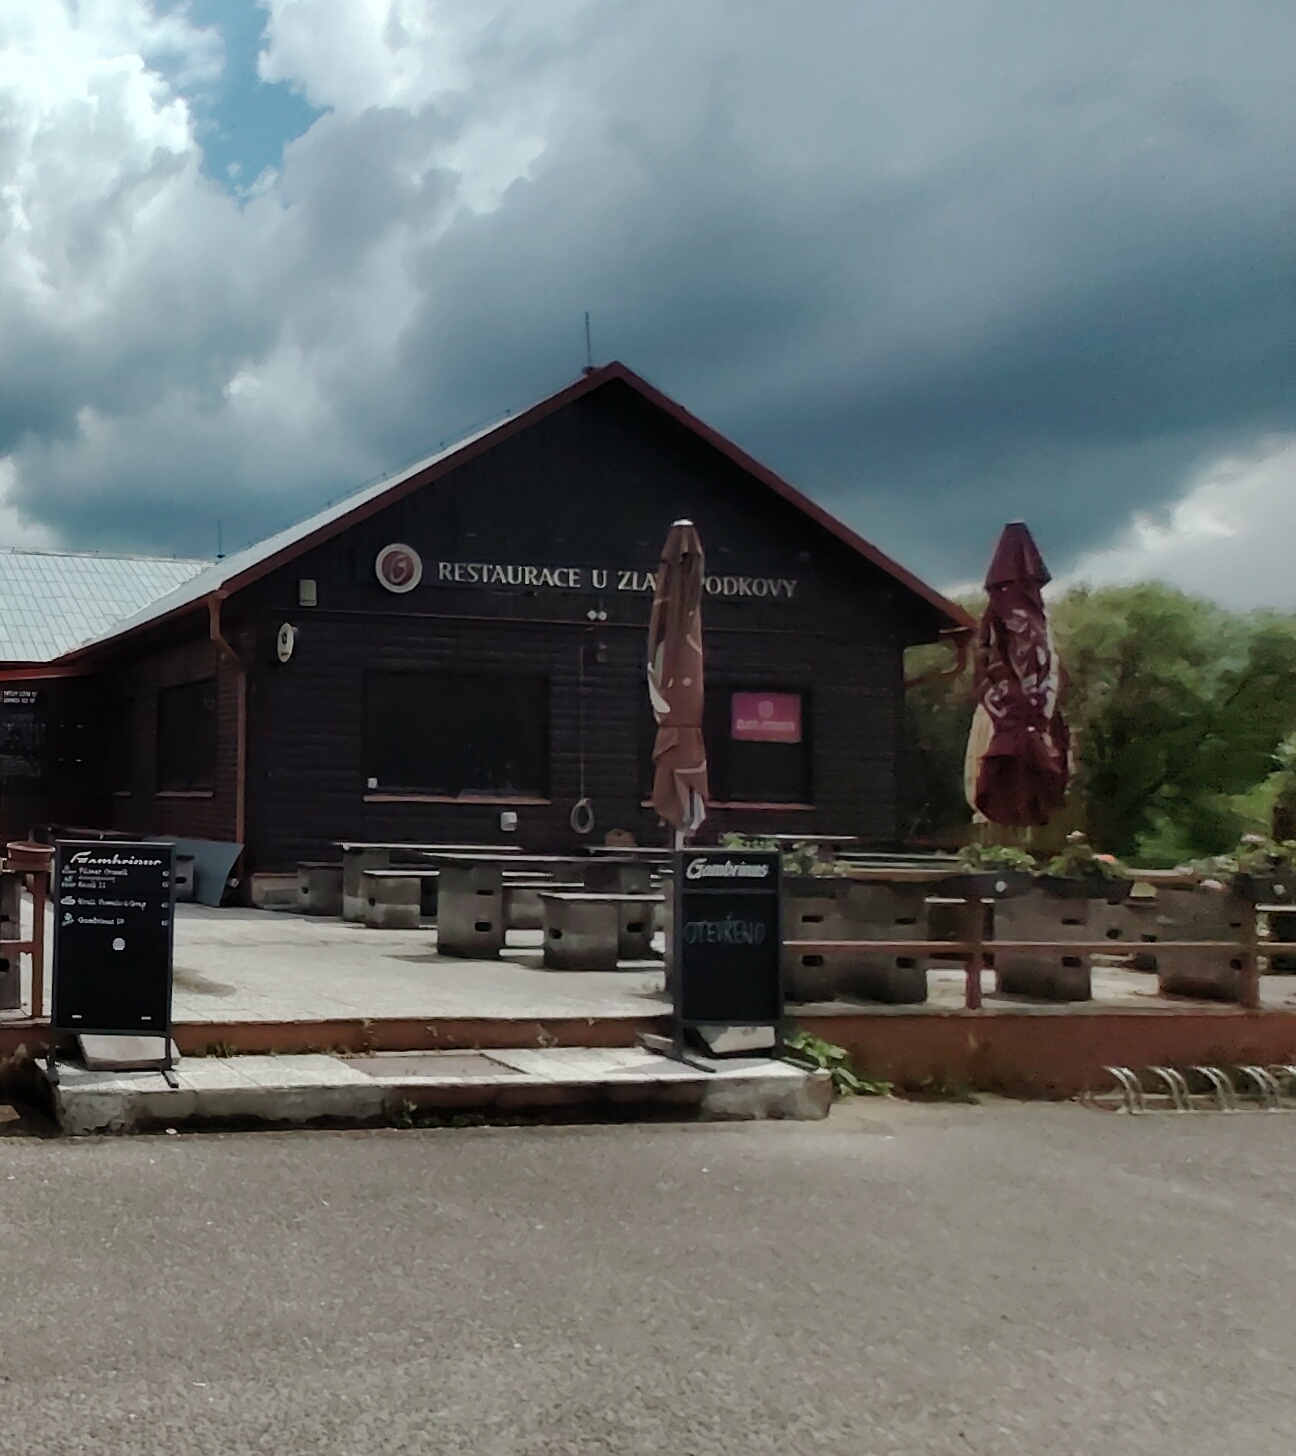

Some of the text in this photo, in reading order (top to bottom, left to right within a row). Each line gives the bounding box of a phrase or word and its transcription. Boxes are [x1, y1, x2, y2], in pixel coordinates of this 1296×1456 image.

[438, 562, 797, 598] RESTAURACE U ZLA ODKOVY
[686, 858, 769, 879] Gambrinus
